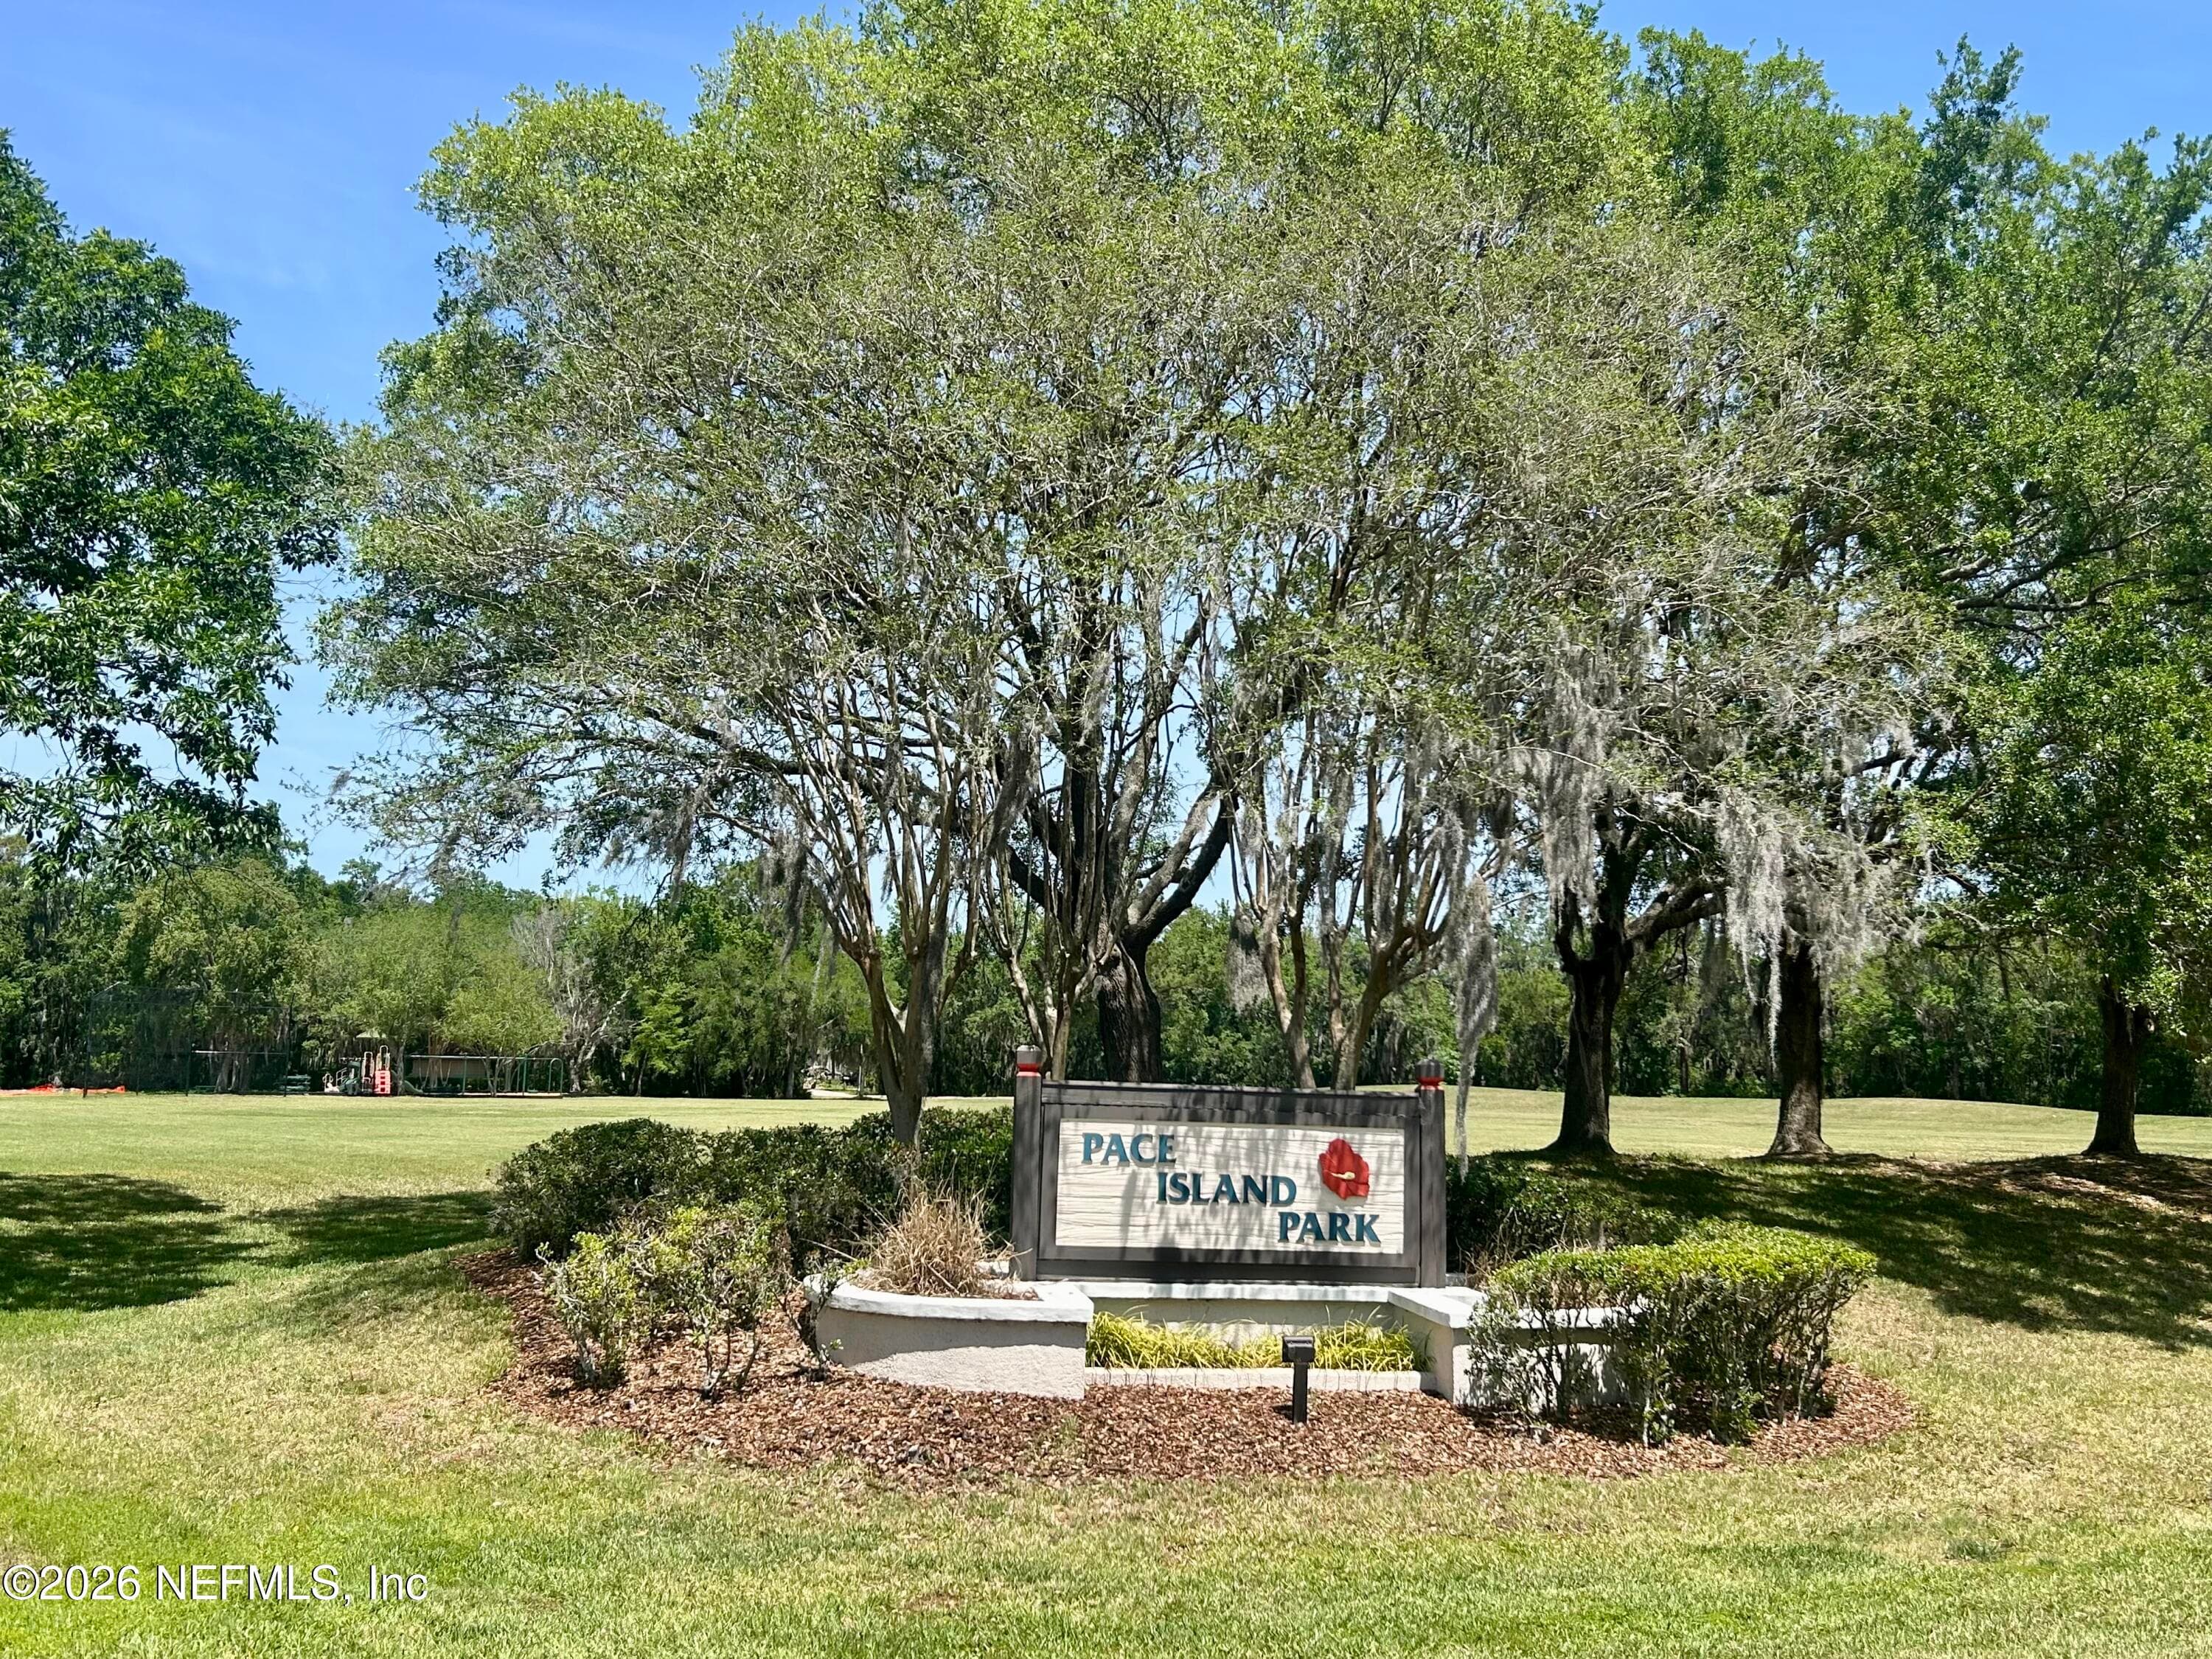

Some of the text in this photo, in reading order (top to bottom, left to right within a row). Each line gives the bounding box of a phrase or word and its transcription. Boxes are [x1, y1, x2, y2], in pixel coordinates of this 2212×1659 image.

[1081, 1132, 1177, 1167] PACE
[1156, 1171, 1297, 1207] ISLAND
[1277, 1211, 1381, 1247] PARK
